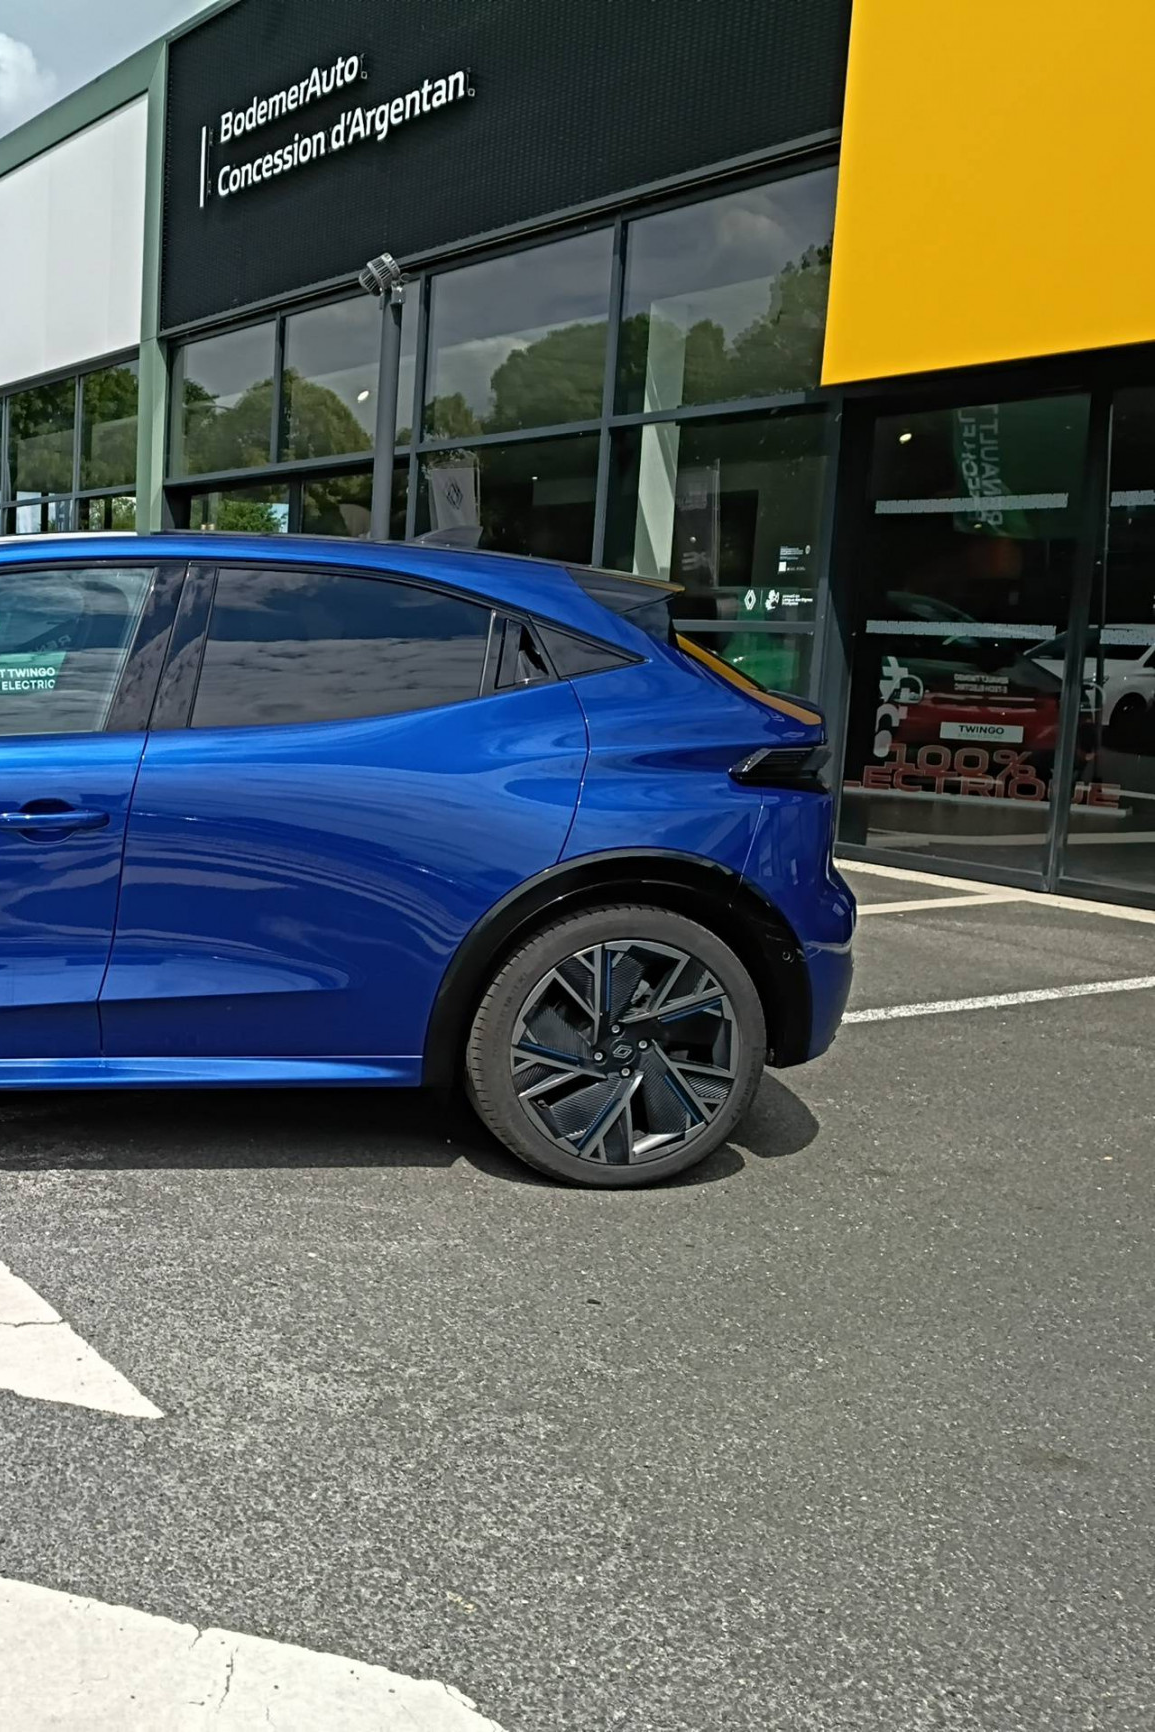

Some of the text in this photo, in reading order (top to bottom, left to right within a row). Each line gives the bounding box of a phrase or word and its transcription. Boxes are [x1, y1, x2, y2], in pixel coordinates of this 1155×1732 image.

[220, 54, 359, 143] BodemerAuto
[218, 70, 465, 197] Concession d'Argentan
[7, 667, 56, 679] TWINGO
[2, 679, 56, 691] ELECTRIC
[959, 725, 1004, 735] TWINGO
